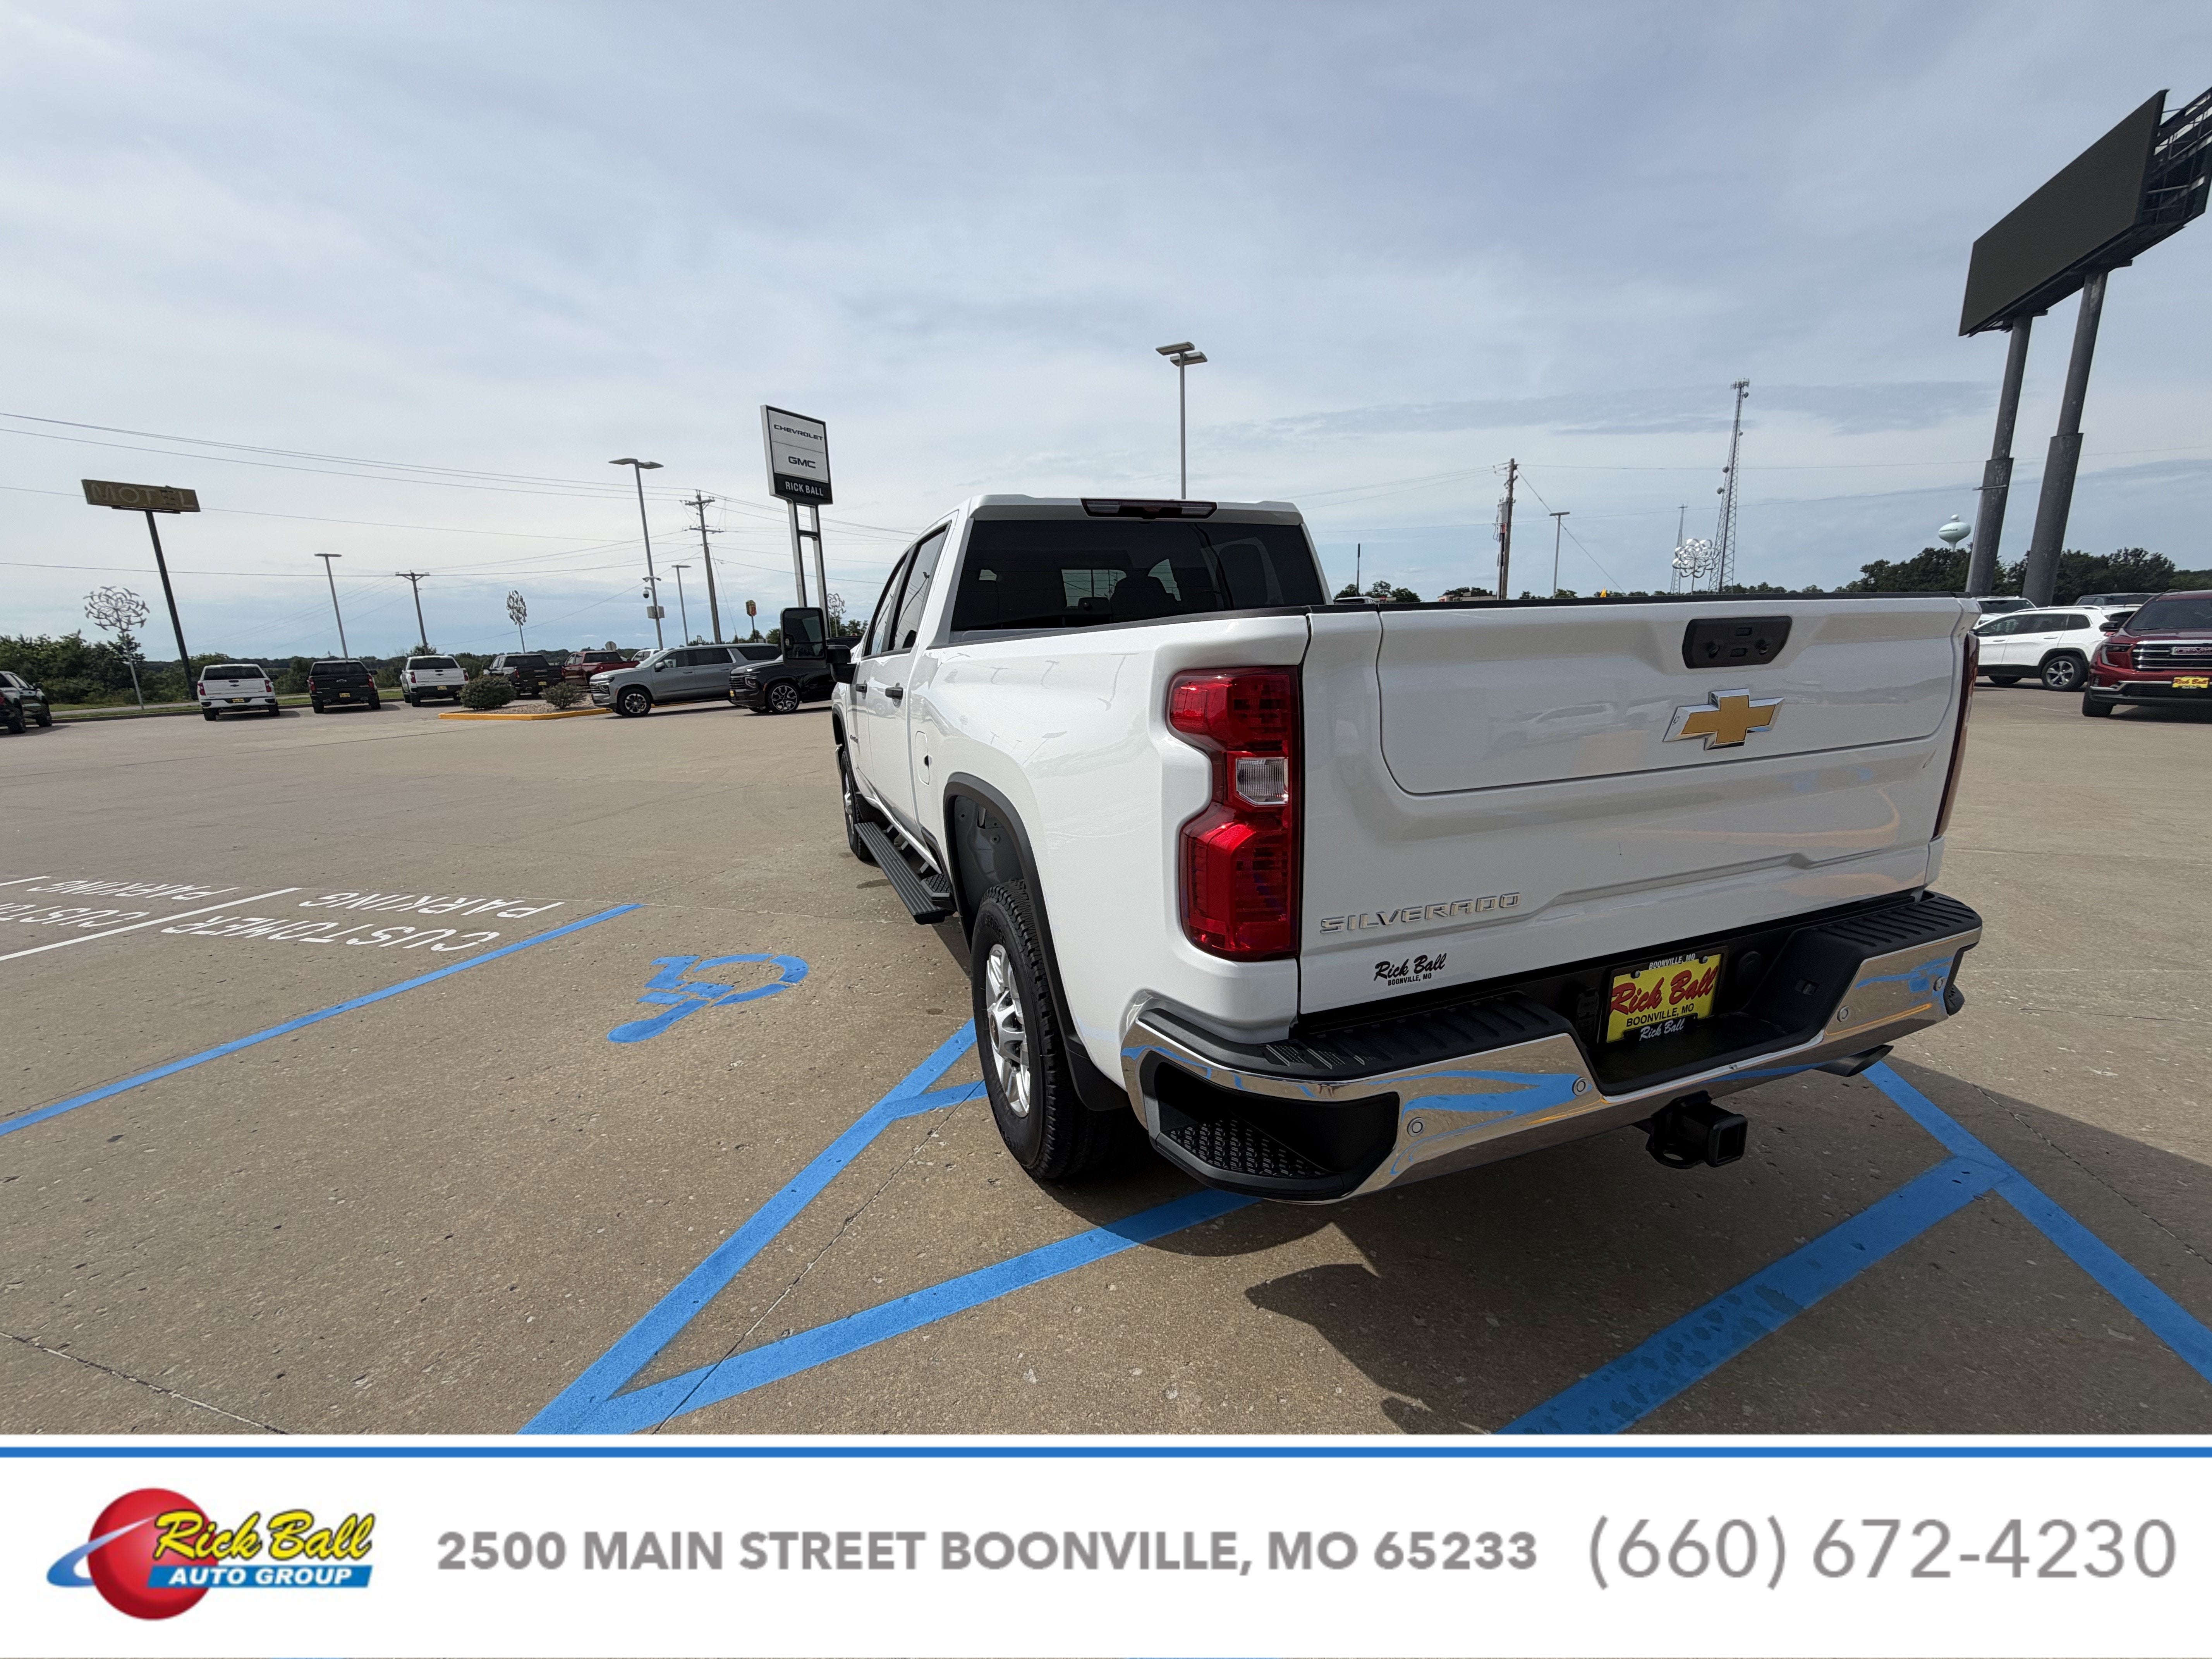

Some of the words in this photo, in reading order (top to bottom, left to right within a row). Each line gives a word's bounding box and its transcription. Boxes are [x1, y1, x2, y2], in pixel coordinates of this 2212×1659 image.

[774, 424, 823, 441] CHEVROLET
[788, 456, 816, 469] GMC
[91, 483, 194, 508] MOTEL
[785, 481, 804, 492] RICK
[806, 485, 824, 496] BALL
[27, 879, 240, 901] PARKING
[299, 892, 565, 919] PARKING
[1320, 892, 1522, 934] SILVERADO
[161, 915, 500, 951] CUSTOMER
[1374, 958, 1409, 981] Rick
[1414, 953, 1447, 974] Ball
[1649, 956, 1684, 970] BOONVILLE,
[1686, 953, 1695, 962] MO
[1388, 975, 1420, 986] BOONVILLE,
[1610, 977, 1665, 1015] Rick
[1669, 965, 1719, 1005] Ball
[1626, 1008, 1679, 1027] BOONVILLE,
[1681, 1003, 1694, 1015] MO
[1639, 1023, 1662, 1041] Rick
[1664, 1018, 1685, 1034] Ball
